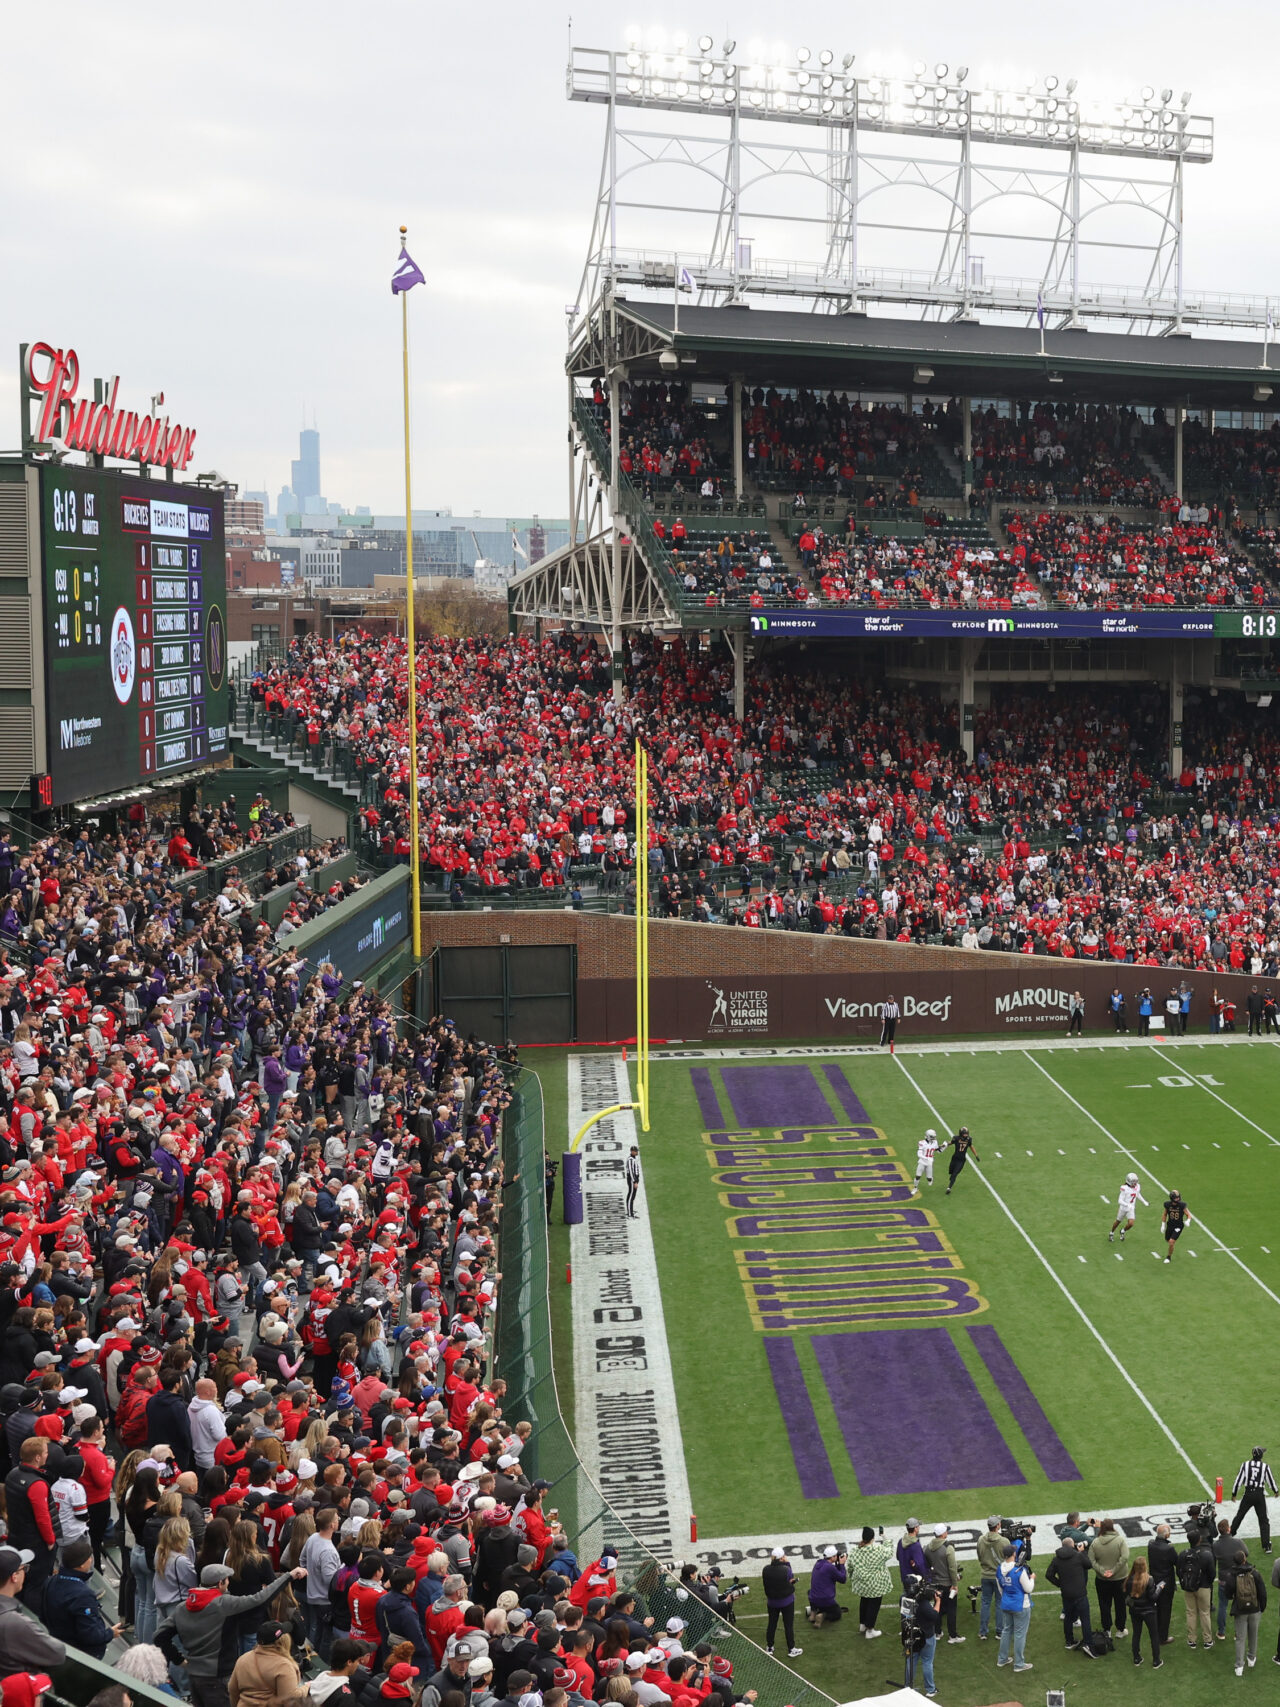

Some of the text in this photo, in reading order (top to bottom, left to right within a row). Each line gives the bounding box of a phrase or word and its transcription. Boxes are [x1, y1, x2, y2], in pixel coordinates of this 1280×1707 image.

[24, 342, 196, 471] Budweiser
[54, 488, 76, 533] 8:13
[84, 492, 94, 517] 1ST
[124, 503, 149, 526] BUCKEYES
[154, 510, 186, 530] TEAM STATS
[189, 512, 209, 532] WILDCATS
[142, 545, 146, 566] 0
[55, 569, 67, 591] OSU
[74, 568, 80, 600] 0
[94, 566, 98, 587] 3
[142, 579, 146, 600] 0
[95, 596, 99, 616] 7
[60, 614, 68, 635] NU
[75, 610, 81, 643] 0
[143, 613, 147, 634] 0
[865, 623, 902, 631] the north
[881, 616, 891, 624] of
[1103, 625, 1137, 633] the north
[1242, 615, 1276, 636] 8:13
[73, 717, 101, 731] Northwestern
[145, 716, 150, 736] 0
[74, 732, 92, 747] Medicine
[146, 749, 150, 770] 0
[39, 776, 52, 805] 40
[730, 991, 768, 1000] UNITED
[730, 1000, 768, 1009] STATES
[996, 988, 1075, 1015] MARQUE
[730, 1009, 768, 1018] VIRGIN
[825, 996, 952, 1021] Vienn Beef
[731, 1018, 768, 1026] ISLANDS
[1157, 1075, 1224, 1087] 10
[1130, 1193, 1137, 1204] 7
[700, 1126, 990, 1331] WILDCATS
[598, 1268, 633, 1304] Abbott
[595, 1390, 657, 1428] DRIVE
[598, 1428, 663, 1474] BLOOD
[1252, 1467, 1260, 1480] F
[599, 1474, 668, 1510] GIVE
[263, 1517, 277, 1547] 7
[354, 1599, 361, 1626] 1
